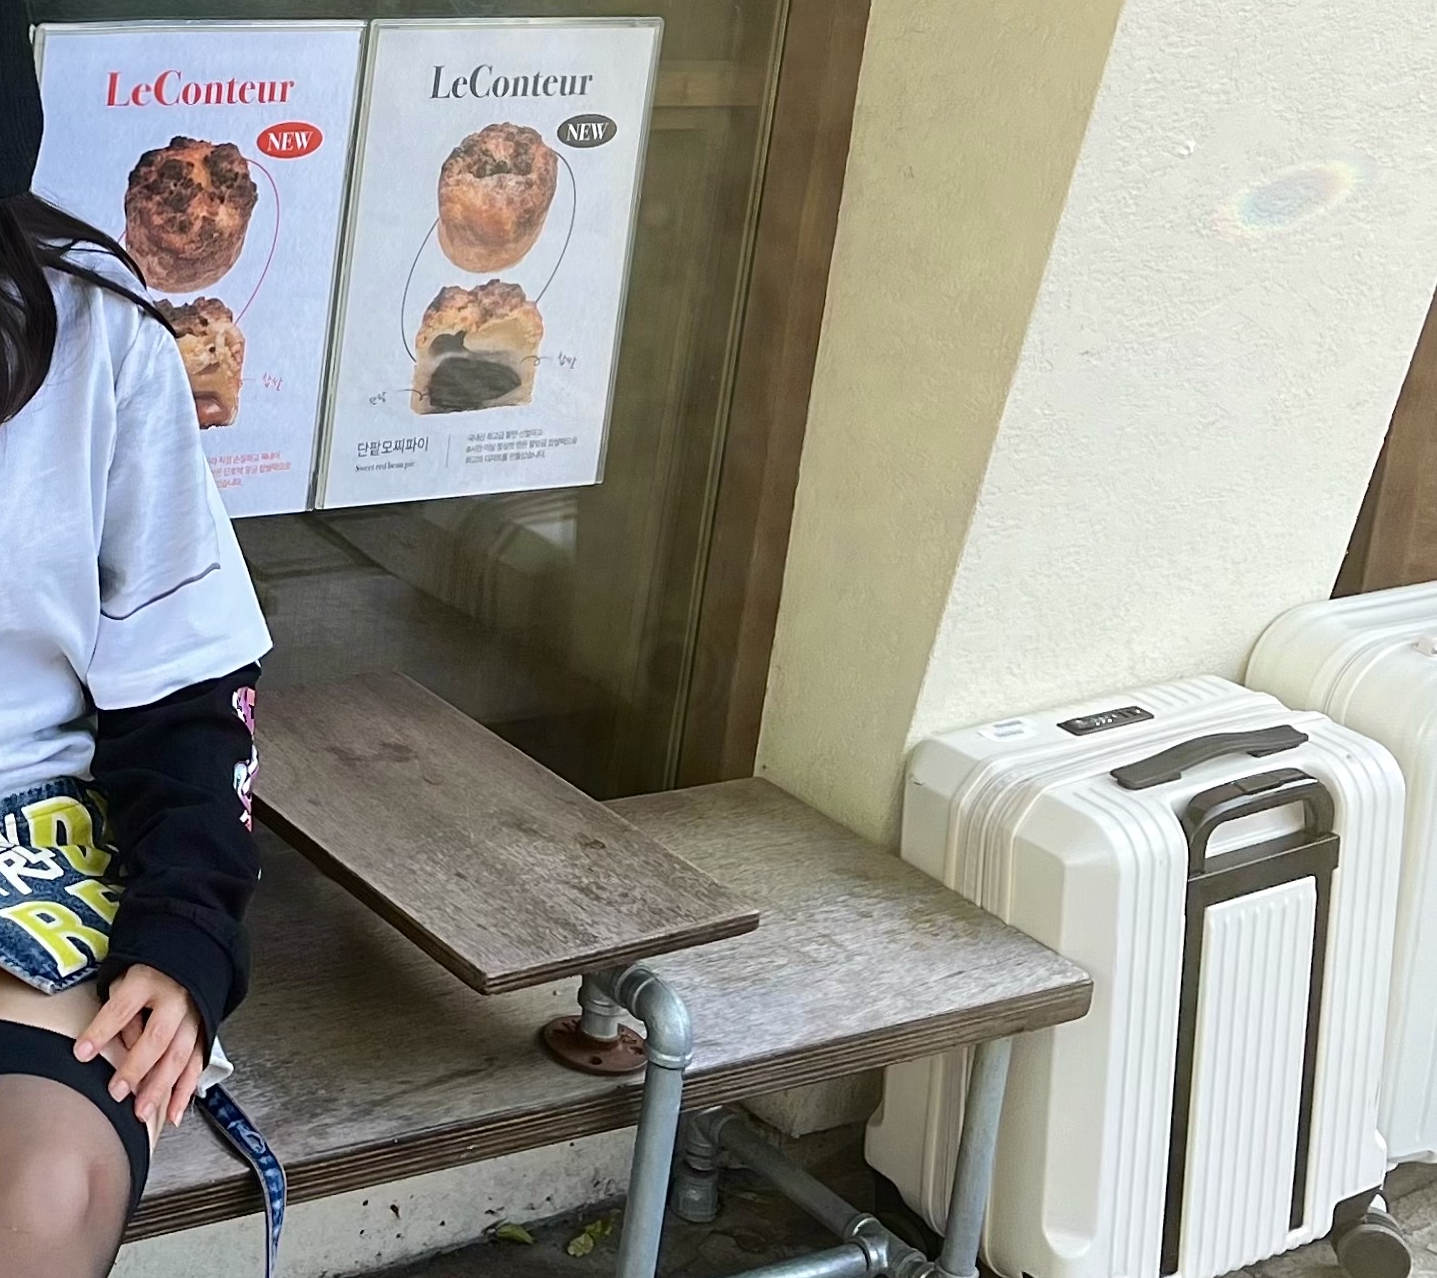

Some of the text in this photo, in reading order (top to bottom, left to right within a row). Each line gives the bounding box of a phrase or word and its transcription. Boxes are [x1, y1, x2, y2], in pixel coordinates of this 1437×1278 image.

[106, 69, 295, 107] LeConteur
[429, 64, 593, 99] LeConteur
[266, 131, 313, 152] NEW
[566, 122, 609, 142] NEW
